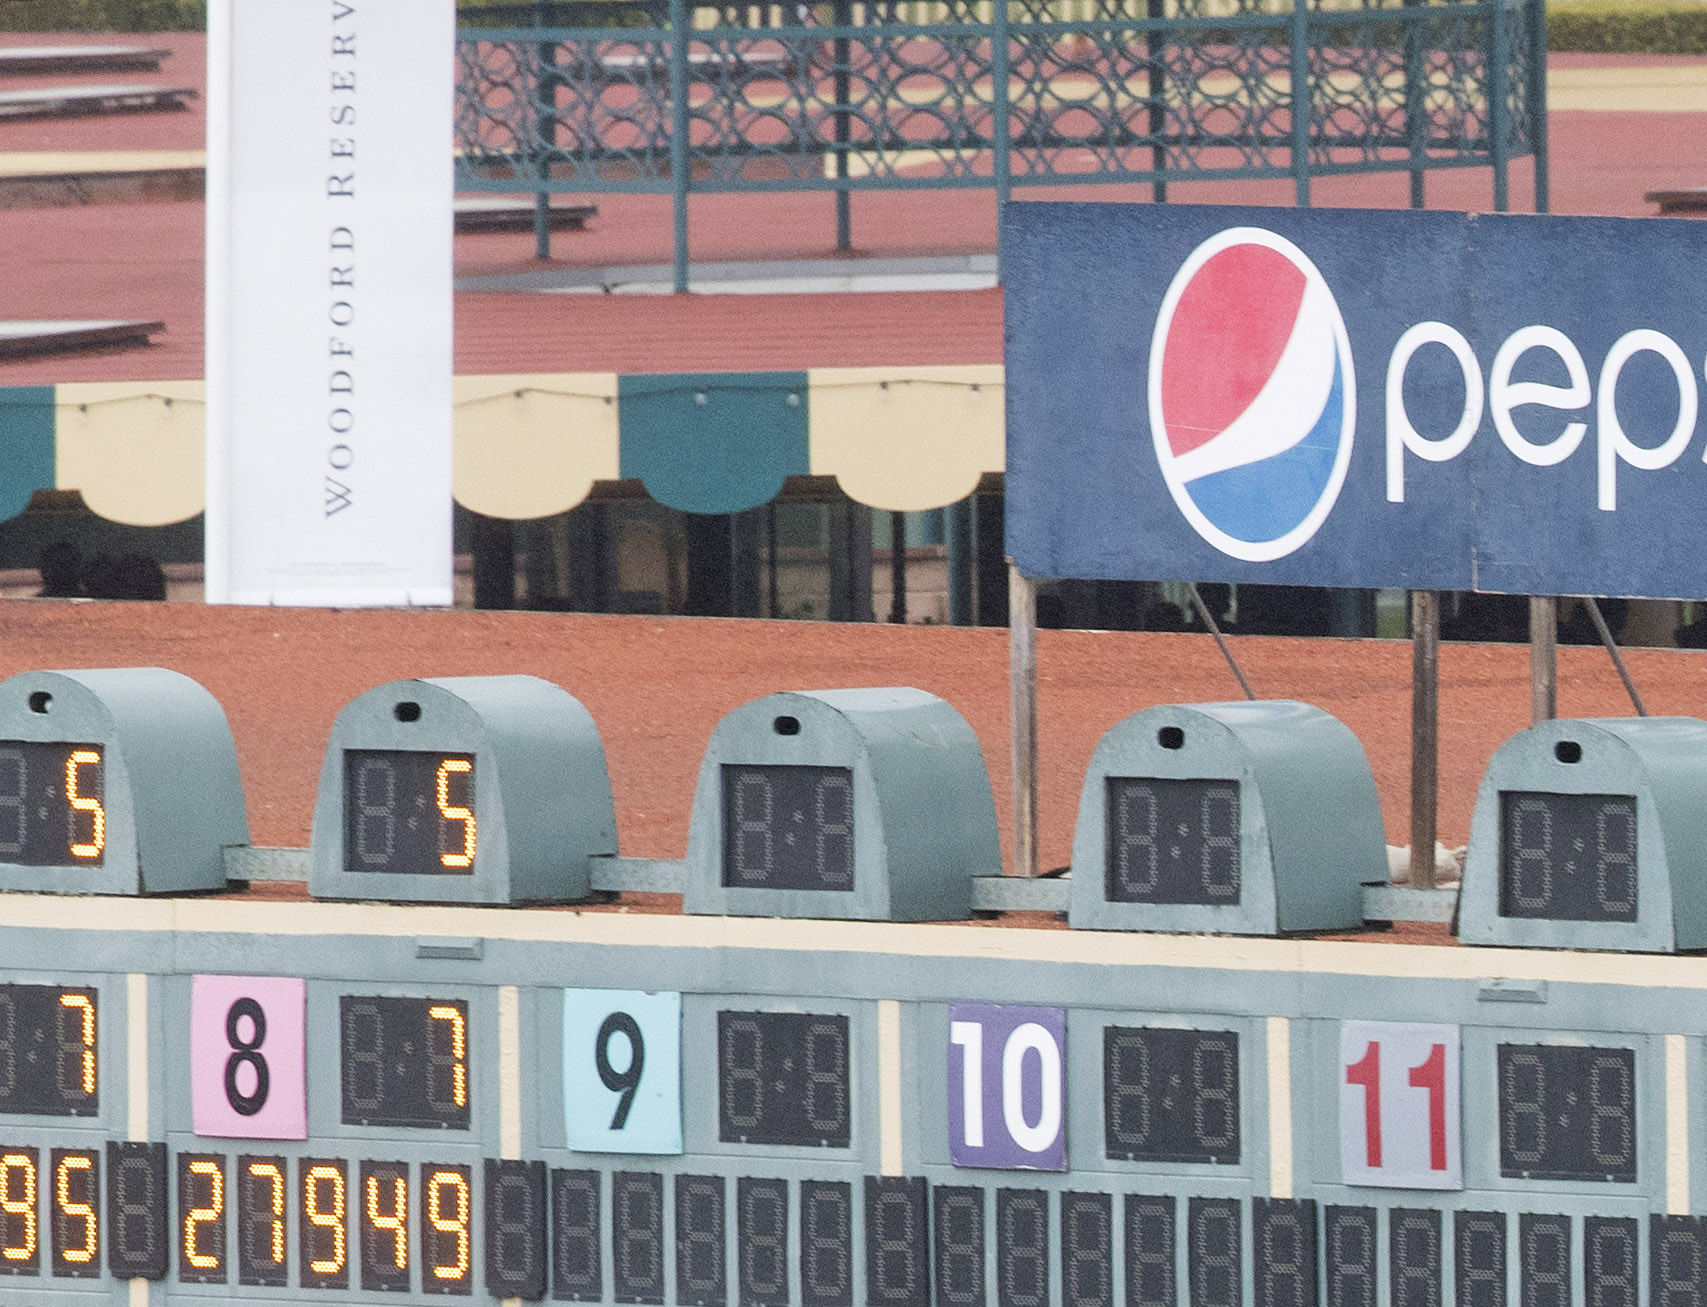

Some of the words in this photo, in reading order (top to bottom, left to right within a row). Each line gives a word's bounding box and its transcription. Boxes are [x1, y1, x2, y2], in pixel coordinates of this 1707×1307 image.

[325, 223, 357, 520] WOODFORD
[65, 750, 106, 858] 5
[436, 759, 478, 868] 5
[60, 994, 96, 1094] 7
[224, 996, 270, 1117] 8
[430, 1006, 468, 1108] 7
[595, 1011, 645, 1131] 9
[950, 1020, 1063, 1152] 10
[1346, 1040, 1448, 1172] 11
[185, 1161, 471, 1280] 27949
